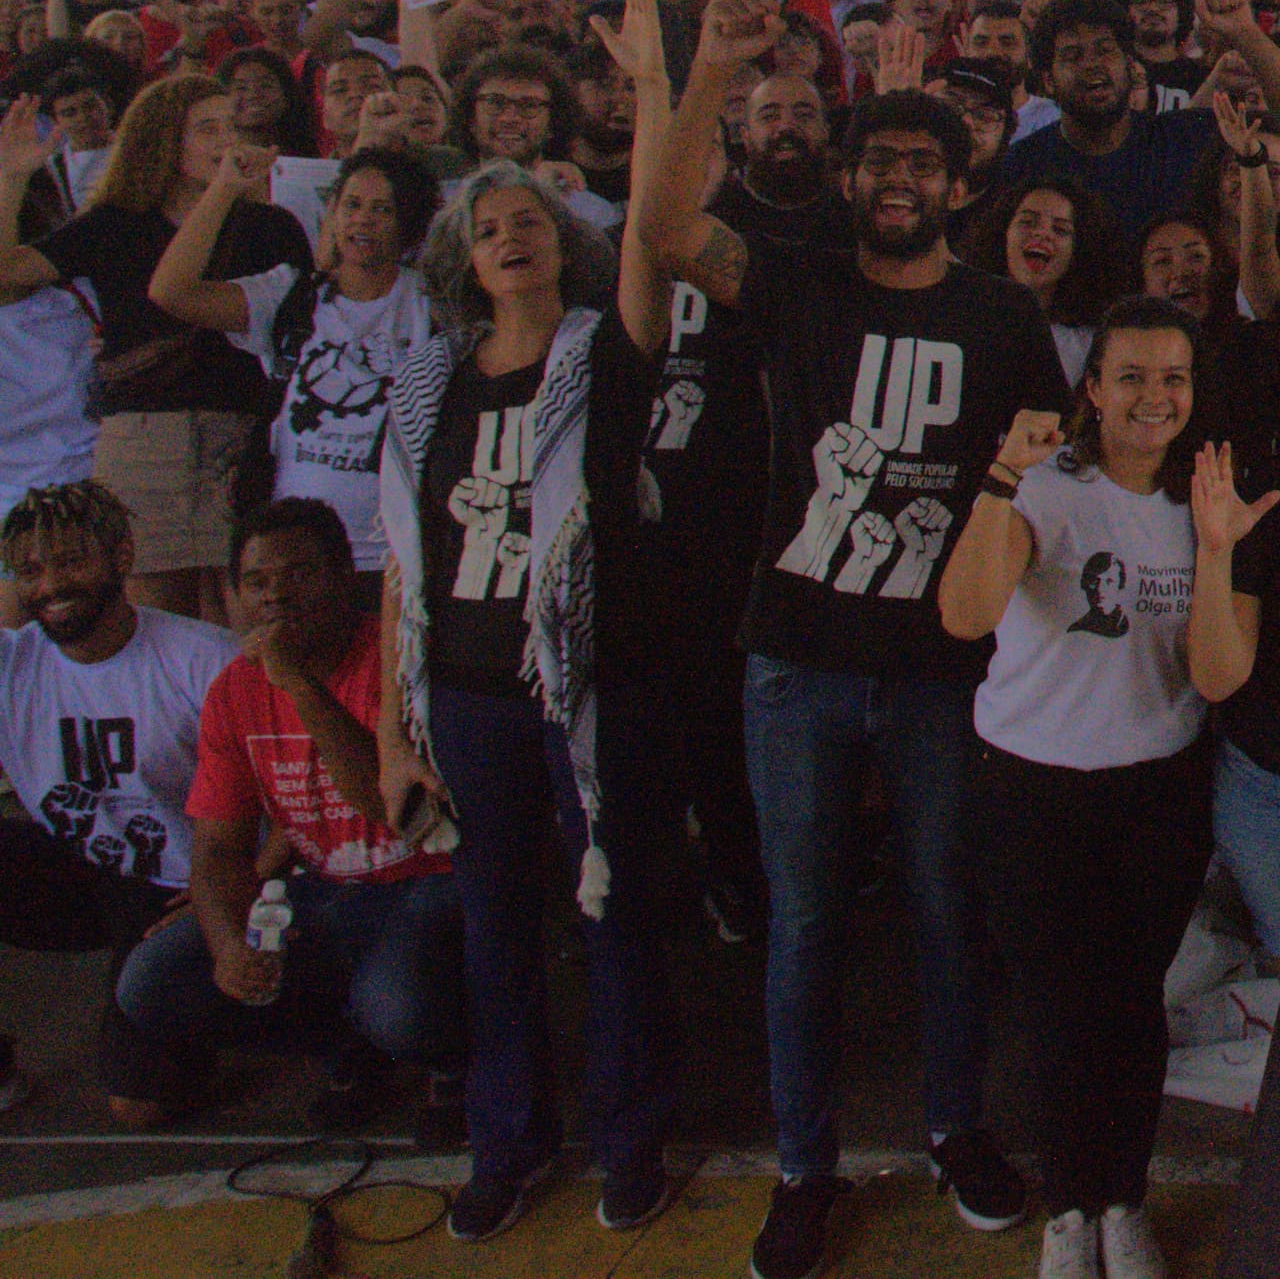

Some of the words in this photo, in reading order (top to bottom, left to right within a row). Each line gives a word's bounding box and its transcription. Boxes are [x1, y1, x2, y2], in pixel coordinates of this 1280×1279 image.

[669, 281, 708, 353] P
[851, 334, 963, 453] UP
[1136, 599, 1172, 616] Olga
[1176, 599, 1193, 614] Be
[1139, 578, 1191, 596] Mulh
[59, 717, 135, 789] UP
